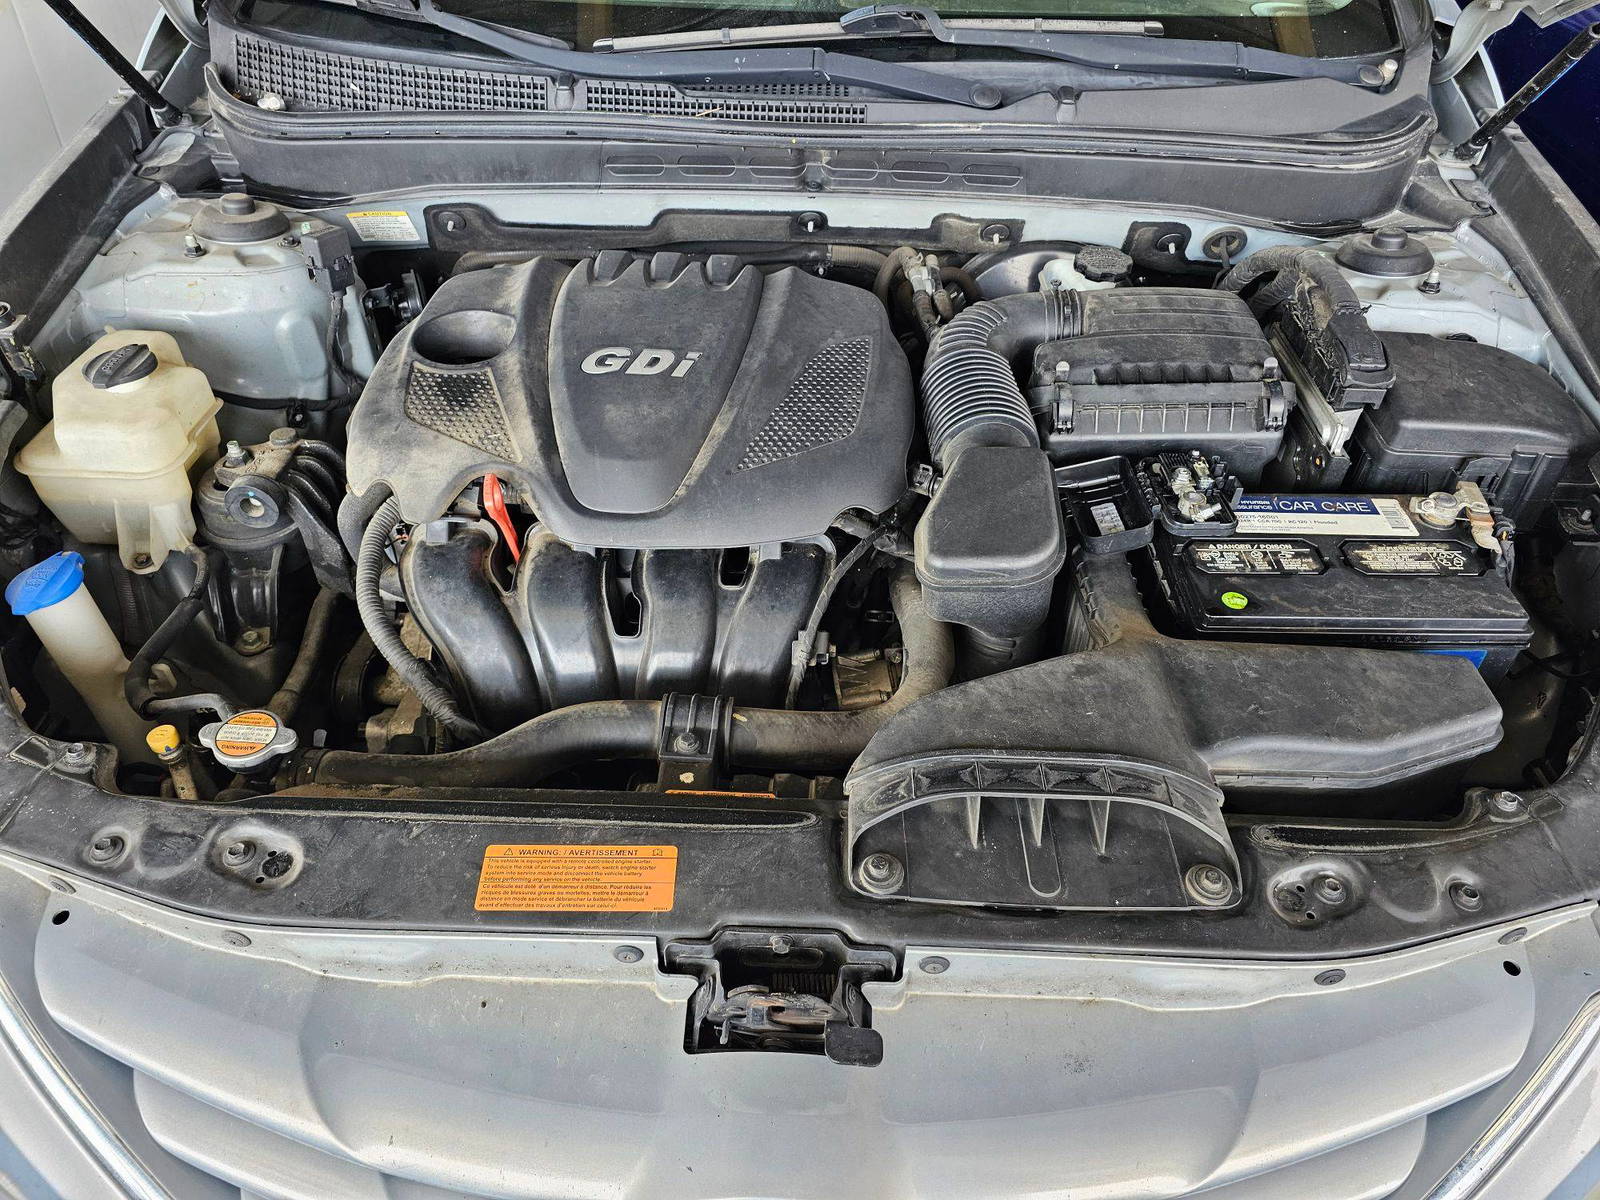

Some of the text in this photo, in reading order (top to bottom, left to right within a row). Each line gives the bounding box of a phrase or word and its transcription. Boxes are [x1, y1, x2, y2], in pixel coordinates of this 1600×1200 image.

[580, 346, 703, 378] GDi
[1280, 501, 1317, 511] CAR
[1321, 502, 1370, 512] CARE
